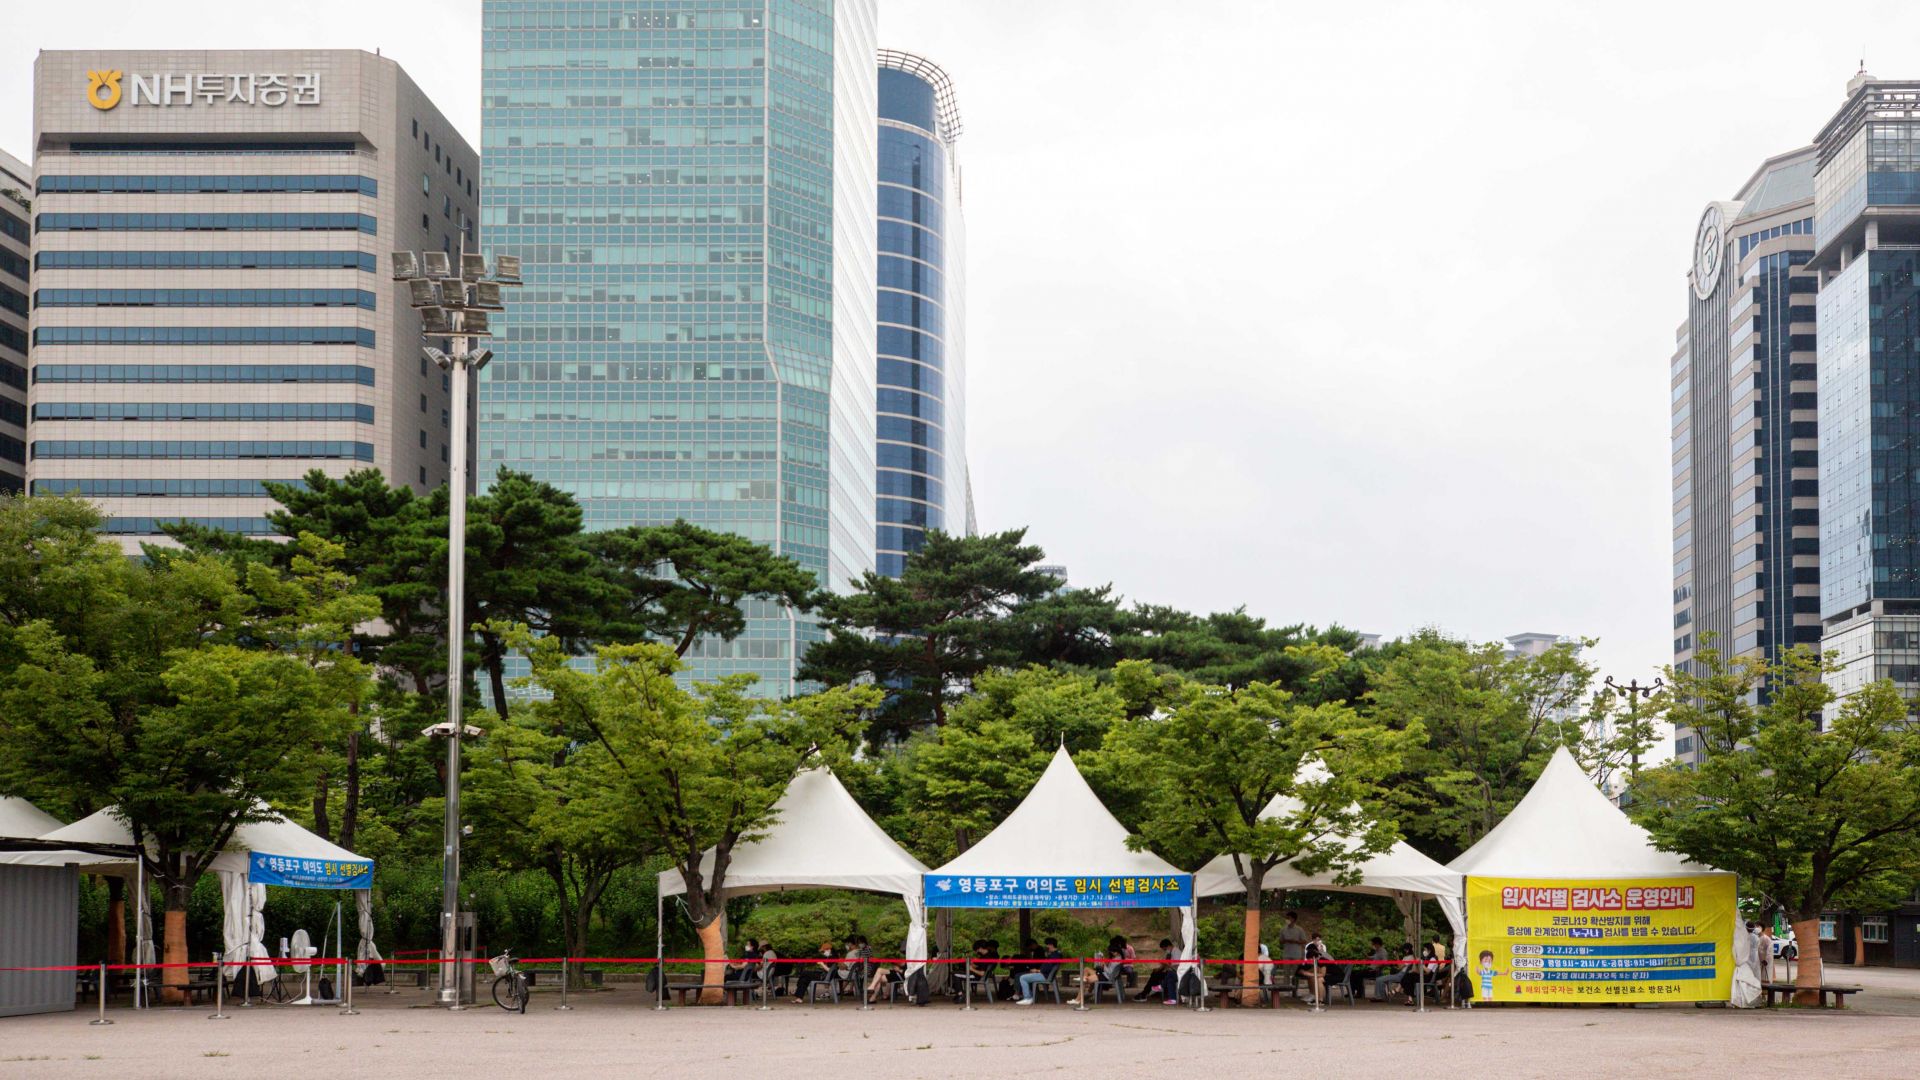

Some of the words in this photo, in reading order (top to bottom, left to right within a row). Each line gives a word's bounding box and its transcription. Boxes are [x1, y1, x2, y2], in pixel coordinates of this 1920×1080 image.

[131, 72, 321, 106] NH투자증권
[269, 857, 300, 873] 영등포구
[303, 861, 323, 874] 여의도
[325, 862, 338, 876] 임시
[959, 878, 1019, 893] 영등포구
[1026, 878, 1068, 893] 여의도
[1074, 878, 1102, 893] 임시
[1108, 878, 1180, 893] 선별검사소
[1502, 887, 1568, 909] 임시선별
[1572, 888, 1622, 910] 검사소
[1626, 887, 1694, 910] 운영안내
[1552, 916, 1587, 926] 코로나19
[1591, 916, 1631, 926] 확산방지를
[1634, 915, 1650, 925] 위해
[1507, 926, 1532, 936] 증상에
[1534, 927, 1567, 937] 관계없이
[1572, 928, 1600, 938] 누구나
[1604, 927, 1629, 937] 검사를
[1632, 927, 1648, 937] 받을
[1651, 927, 1659, 936] 수
[1661, 926, 1697, 936] 있습니다.
[1514, 946, 1541, 954] 운영기간
[1514, 958, 1541, 966] 운영시간
[1514, 971, 1542, 980] 검사결과
[1577, 986, 1601, 994] 보건소
[1605, 985, 1645, 994] 선별진료소
[1648, 984, 1681, 993] 방문검사
